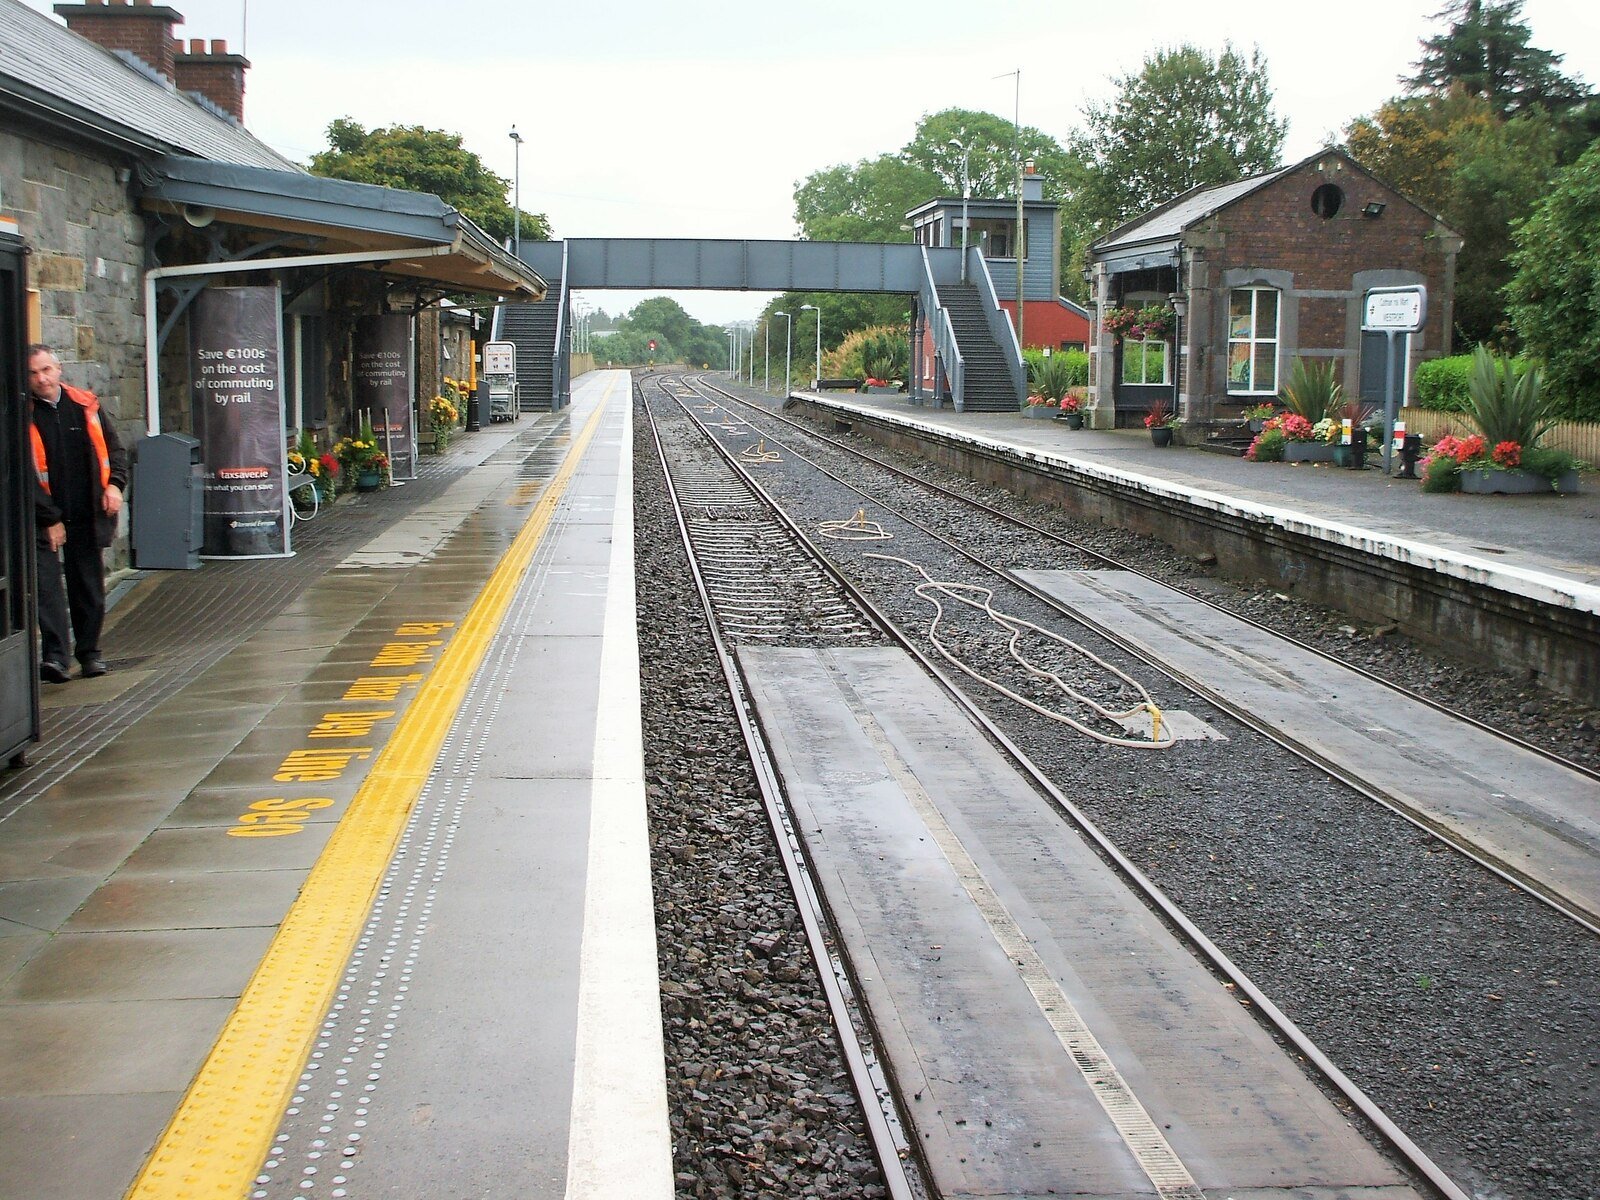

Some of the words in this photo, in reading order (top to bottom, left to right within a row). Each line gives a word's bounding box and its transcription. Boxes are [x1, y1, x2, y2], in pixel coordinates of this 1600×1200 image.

[198, 349, 224, 360] Save
[201, 366, 214, 375] on
[217, 363, 237, 374] the
[240, 362, 266, 374] cost
[365, 370, 406, 378] commuting
[207, 377, 274, 391] commuting
[370, 379, 379, 388] by
[380, 378, 392, 386] rail
[215, 393, 229, 406] by
[231, 392, 251, 403] rail
[221, 469, 269, 479] taxsaver.ie
[230, 485, 243, 493] you
[307, 711, 396, 738] Den
[226, 797, 335, 837] Seo
